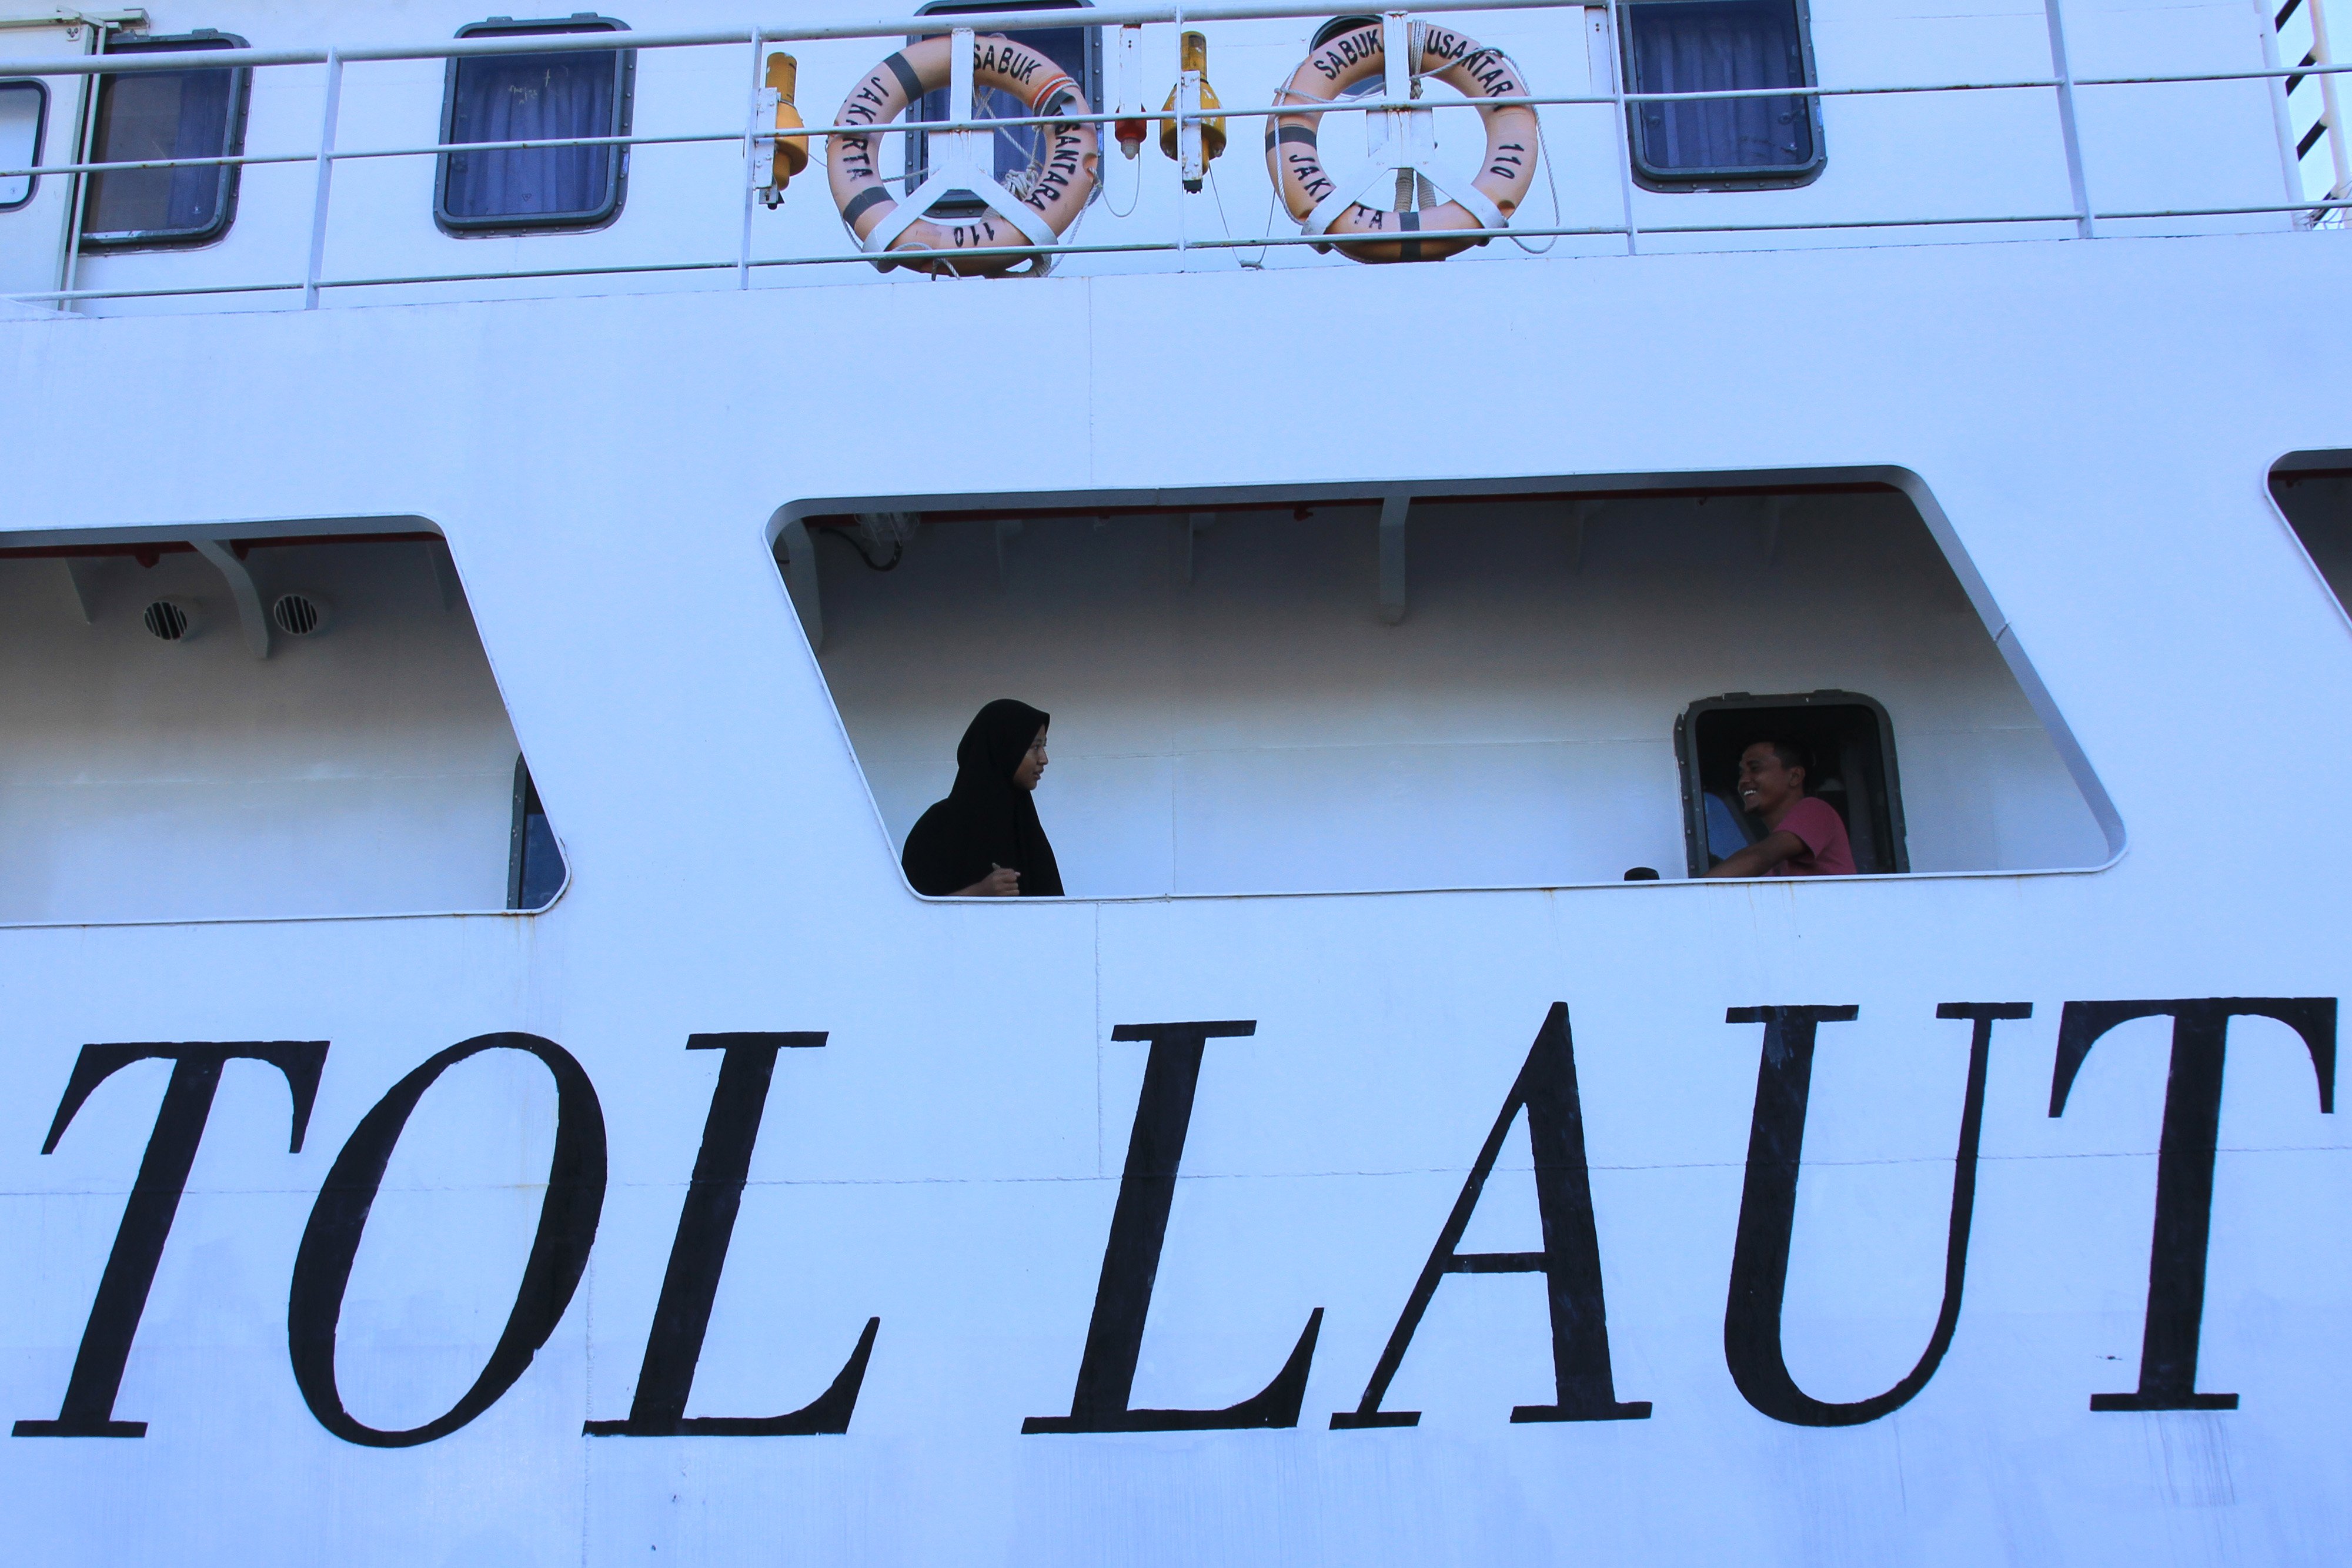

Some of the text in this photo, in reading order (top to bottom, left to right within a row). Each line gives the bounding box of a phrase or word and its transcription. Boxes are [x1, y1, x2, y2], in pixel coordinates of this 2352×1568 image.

[954, 44, 1081, 248] SABUK SANTARA 110
[1289, 154, 1382, 230] JAKTA
[1314, 29, 1525, 179] SABUK USANTAR 110
[12, 997, 2337, 1448] TOL LAUT
